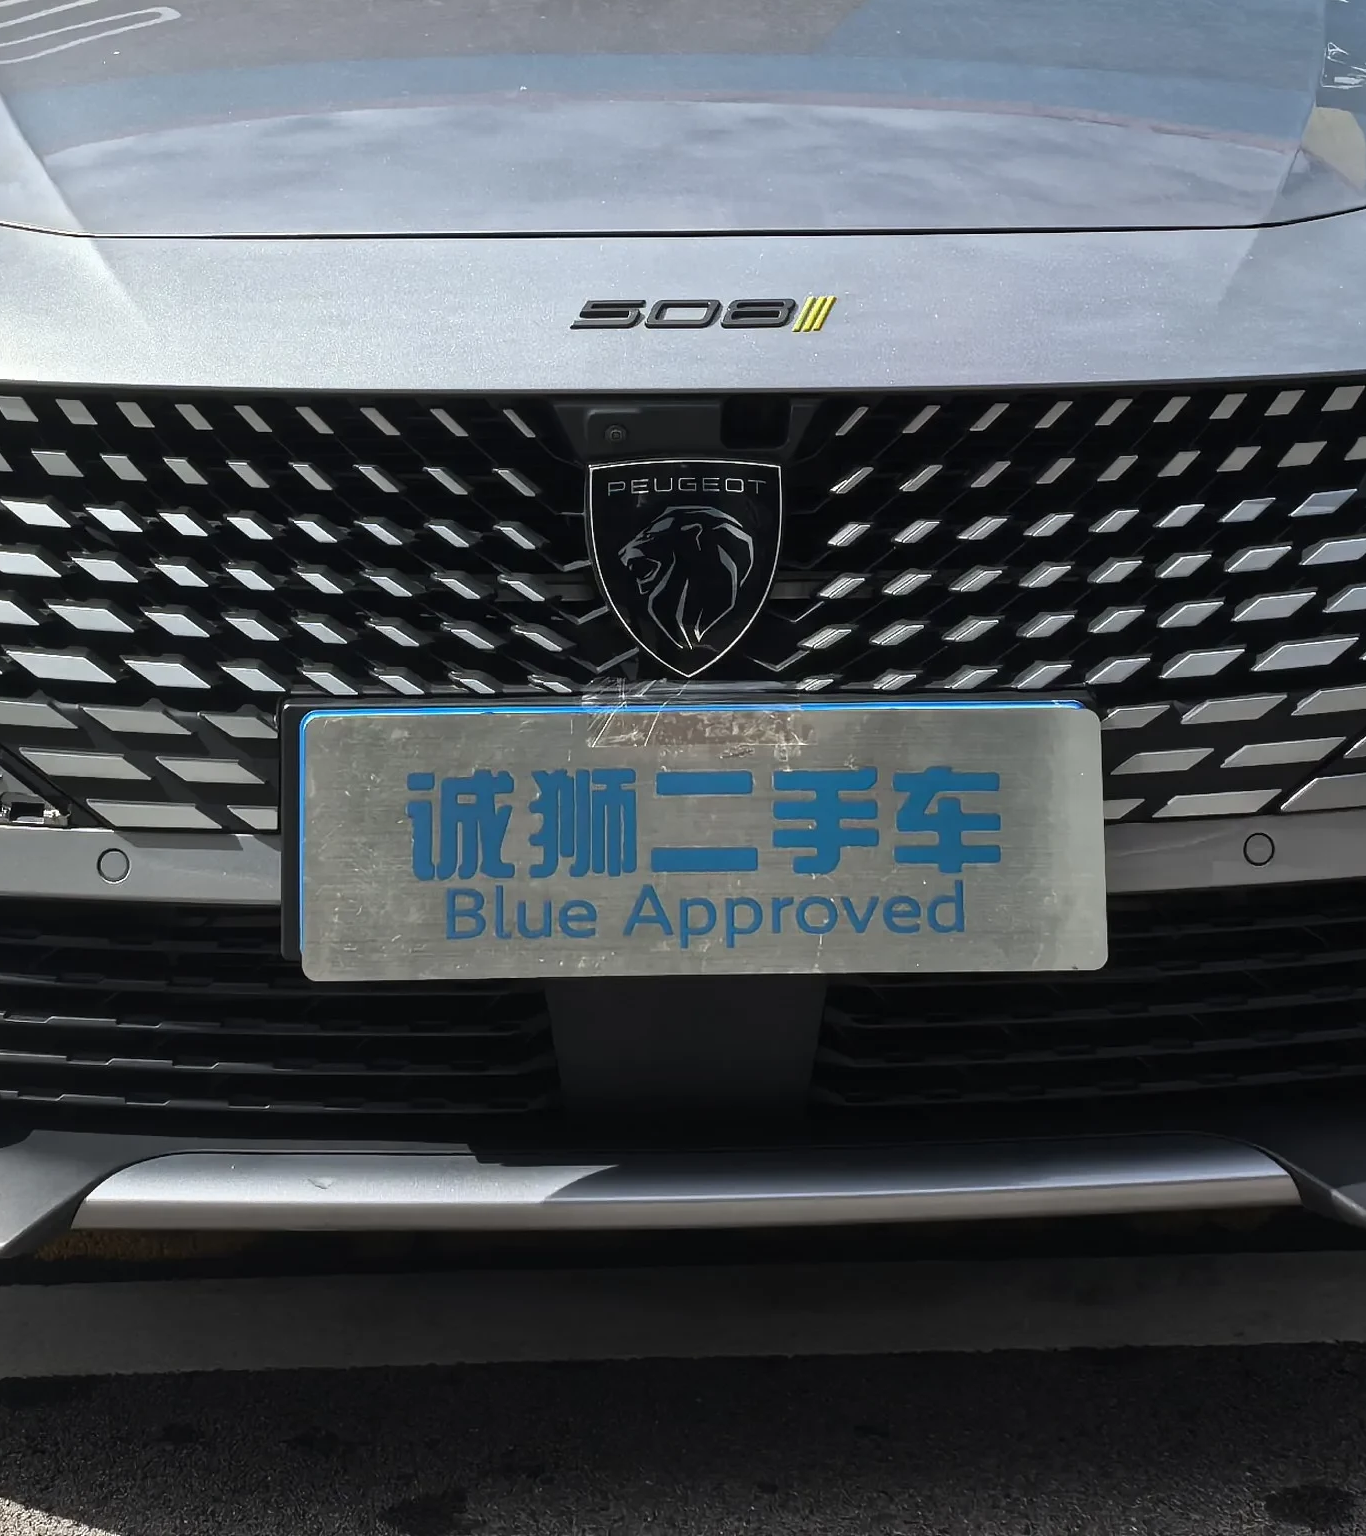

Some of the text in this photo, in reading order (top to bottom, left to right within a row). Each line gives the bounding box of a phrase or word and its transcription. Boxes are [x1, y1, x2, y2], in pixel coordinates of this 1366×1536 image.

[607, 476, 767, 497] PEUGEOT
[406, 767, 1002, 882] 诚狮二手车
[445, 881, 966, 949] Blue Approved
